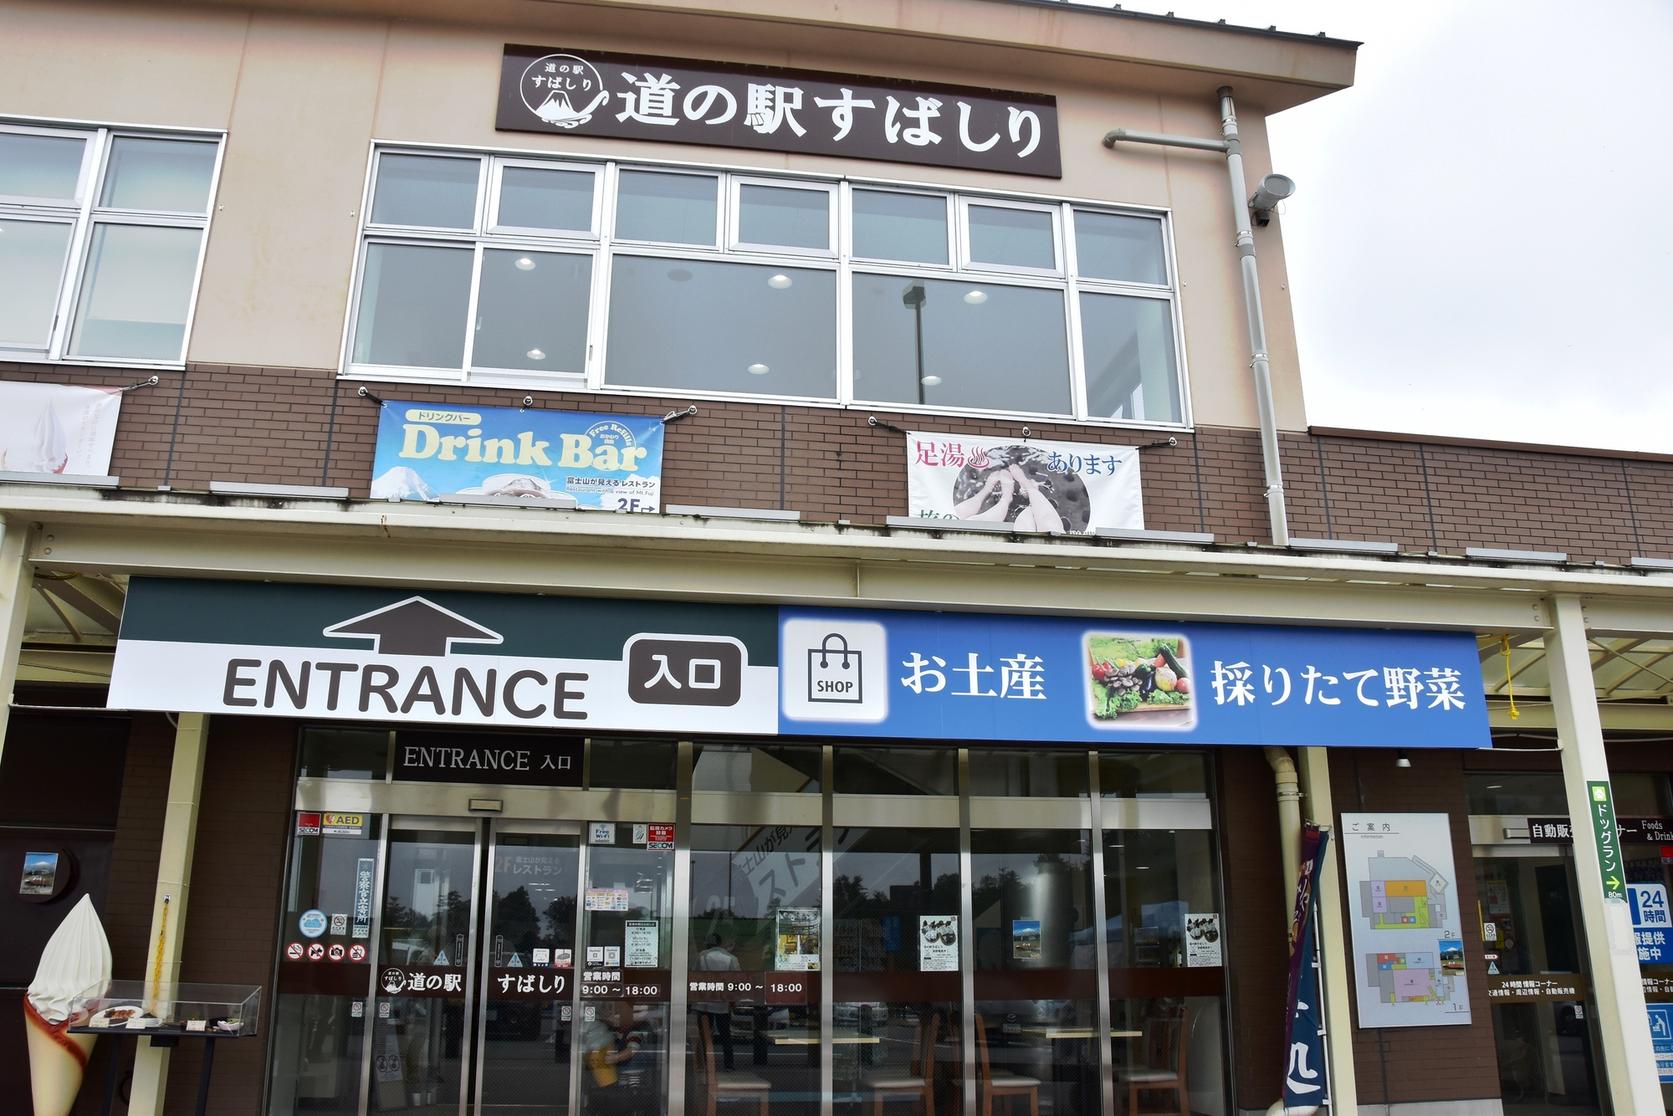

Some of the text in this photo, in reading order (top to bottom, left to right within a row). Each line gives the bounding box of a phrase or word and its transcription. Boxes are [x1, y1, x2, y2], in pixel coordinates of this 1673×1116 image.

[545, 63, 583, 75] 道の駅
[532, 75, 591, 91] すばしり
[416, 411, 470, 423] ドリンクバー
[589, 425, 609, 437] Free
[399, 423, 648, 471] Drink Bar
[915, 440, 1122, 477] 足湯 あります
[567, 476, 656, 489] 富士山が見えるレストラン
[617, 497, 641, 512] 2F
[643, 653, 723, 690] 入口
[900, 650, 1048, 701] お土産
[222, 657, 589, 721] ENTRANCE
[817, 679, 854, 694] SHOP
[1211, 659, 1466, 711] 採りたて野菜
[402, 746, 530, 772] ENTRANCE
[540, 753, 572, 771] 入口
[336, 815, 360, 825] AED
[1352, 822, 1391, 832] ご案内
[1641, 820, 1663, 830] Foods
[1531, 823, 1573, 839] 自動販
[1598, 804, 1616, 872] ドッグラン
[1640, 890, 1665, 908] 24
[1643, 909, 1667, 923] 時間
[407, 972, 565, 994] 道の駅 すばしり
[583, 971, 621, 982] 営業時間
[582, 985, 608, 995] 9:00
[625, 986, 658, 995] 18:00
[689, 982, 724, 992] 営業時間
[727, 982, 752, 992] 9:00
[770, 983, 803, 993] 18:00
